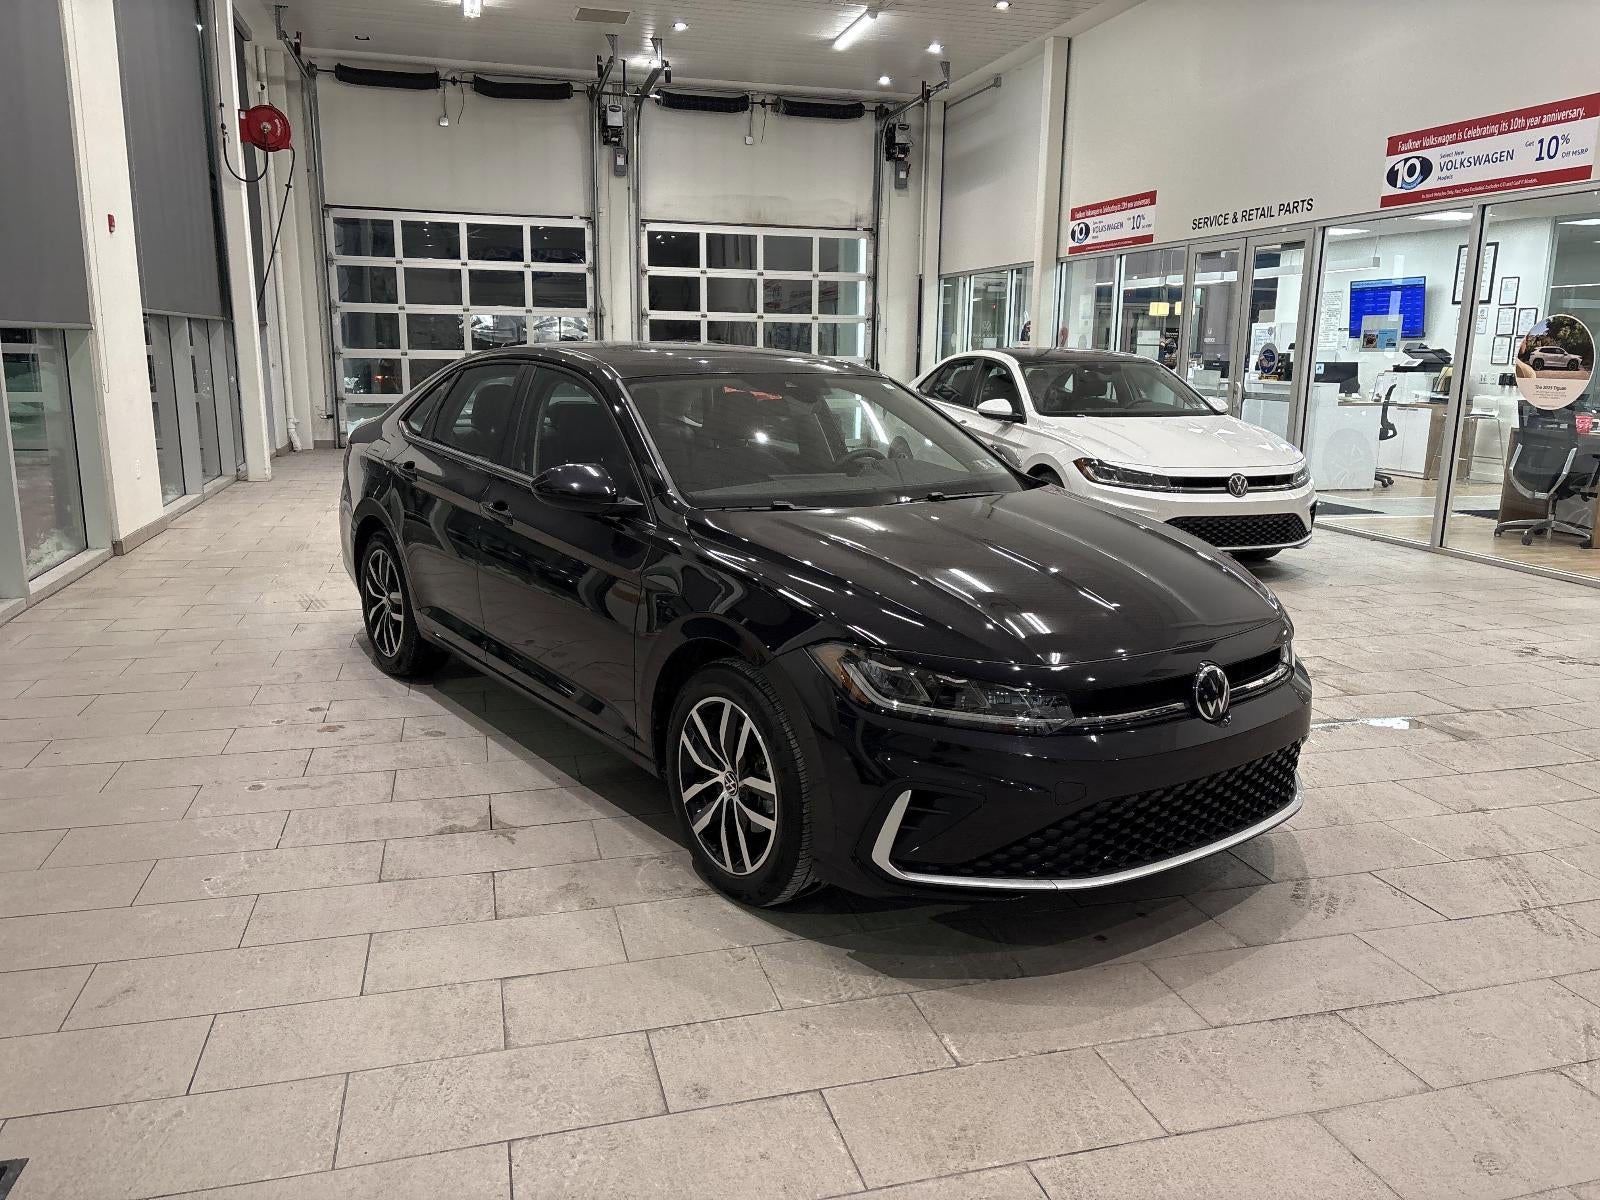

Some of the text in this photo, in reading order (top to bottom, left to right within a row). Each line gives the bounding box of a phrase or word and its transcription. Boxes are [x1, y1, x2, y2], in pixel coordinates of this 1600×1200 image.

[1397, 139, 1422, 152] Faulkner
[1422, 132, 1457, 146] Volkswagen
[1457, 129, 1463, 140] is
[1463, 122, 1499, 139] Celebrating
[1509, 116, 1526, 131] 10th
[1526, 115, 1541, 130] year
[1542, 107, 1586, 123] anniversary.
[1439, 149, 1515, 172] VOLKSWAGEN
[1191, 197, 1314, 231] SERVICE & RETAIL PARTS
